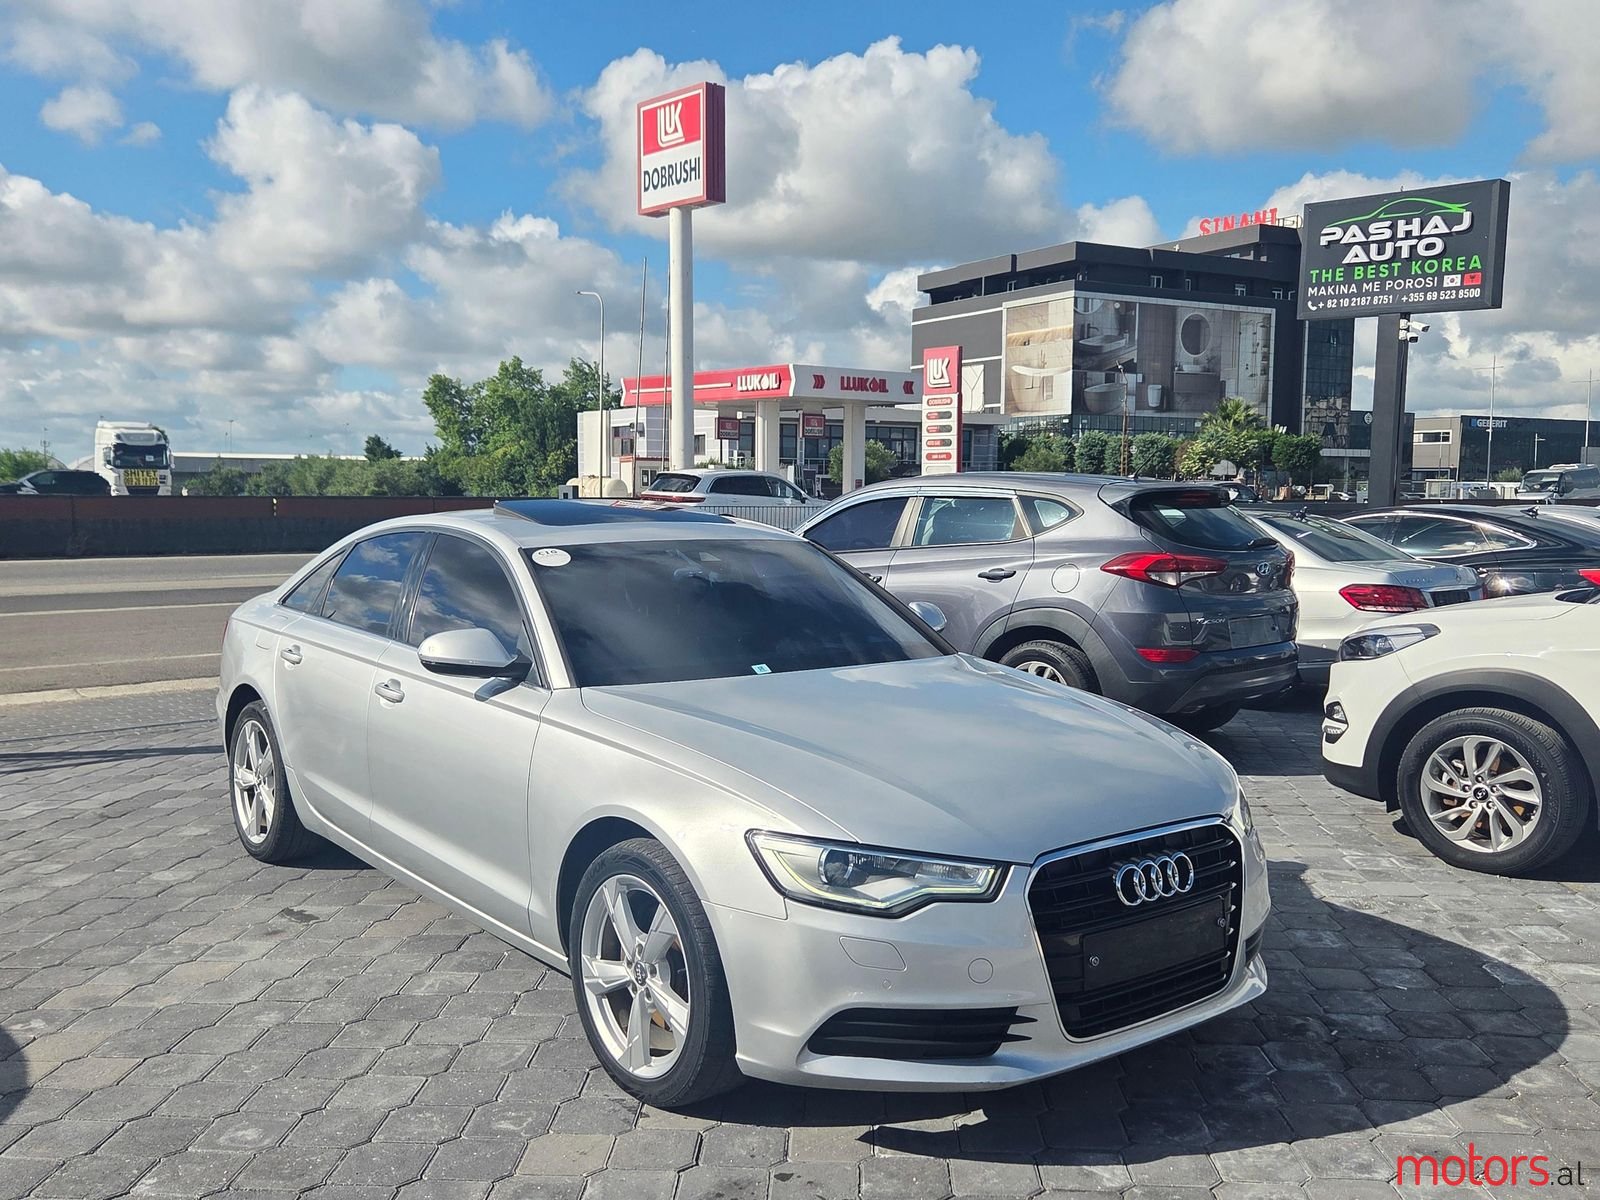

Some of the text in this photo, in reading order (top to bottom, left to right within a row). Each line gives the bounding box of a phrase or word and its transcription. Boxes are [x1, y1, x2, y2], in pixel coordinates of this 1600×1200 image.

[643, 156, 701, 193] DOBRUSHI
[1320, 211, 1473, 246] PASHAJ
[1341, 237, 1445, 264] AUTO
[1310, 255, 1482, 283] THE BEST KOREA
[1308, 276, 1438, 297] MAKINA ME POROSI
[1326, 299, 1337, 309] 82
[1339, 298, 1349, 307] 10
[1351, 296, 1371, 307] 2187
[1373, 295, 1393, 305] 8751
[1401, 292, 1425, 303] +355
[1426, 291, 1438, 301] 69
[1439, 290, 1456, 300] 523
[1458, 287, 1481, 299] 8500
